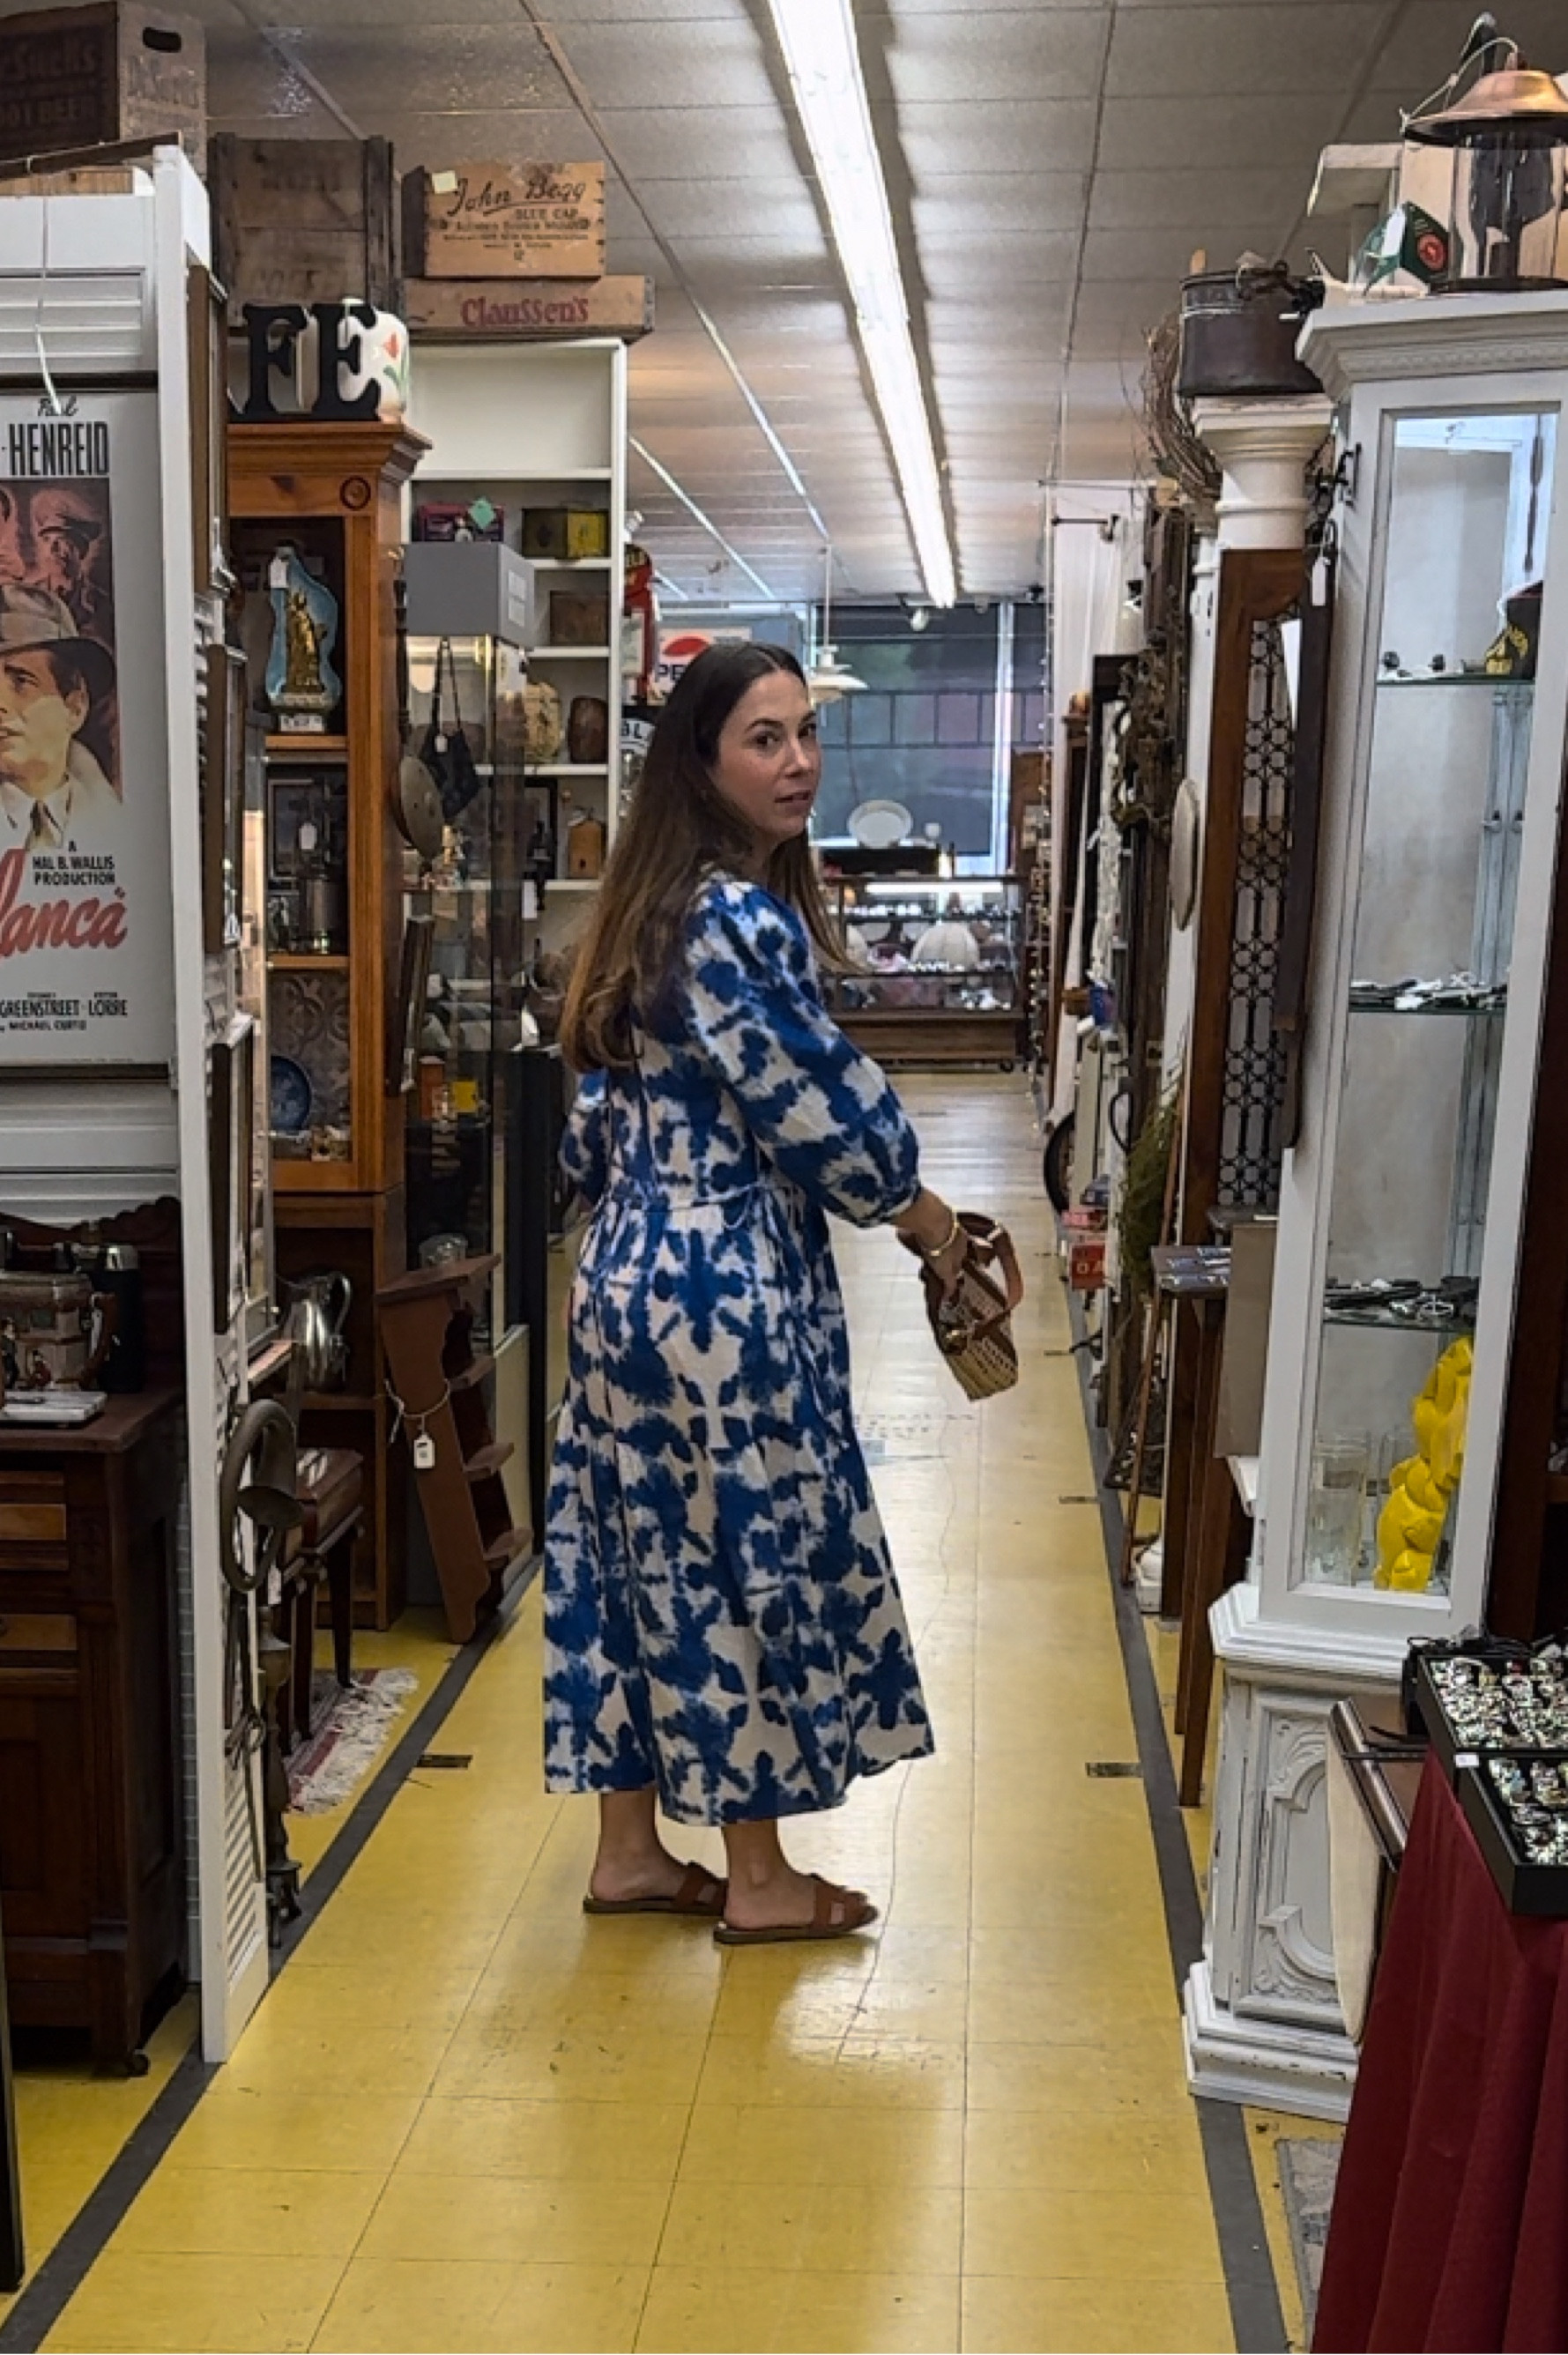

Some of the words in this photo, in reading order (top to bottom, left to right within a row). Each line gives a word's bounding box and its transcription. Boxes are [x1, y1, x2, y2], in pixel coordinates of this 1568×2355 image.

[447, 178, 512, 217] John
[460, 295, 590, 327] Claussen's
[9, 421, 109, 476] HENREID
[68, 841, 77, 852] A
[33, 856, 55, 870] HAL
[71, 855, 115, 870] WALLIS
[34, 871, 115, 886] PRODUCTION
[0, 999, 79, 1018] GREENSTREET
[88, 999, 128, 1017] LORRE
